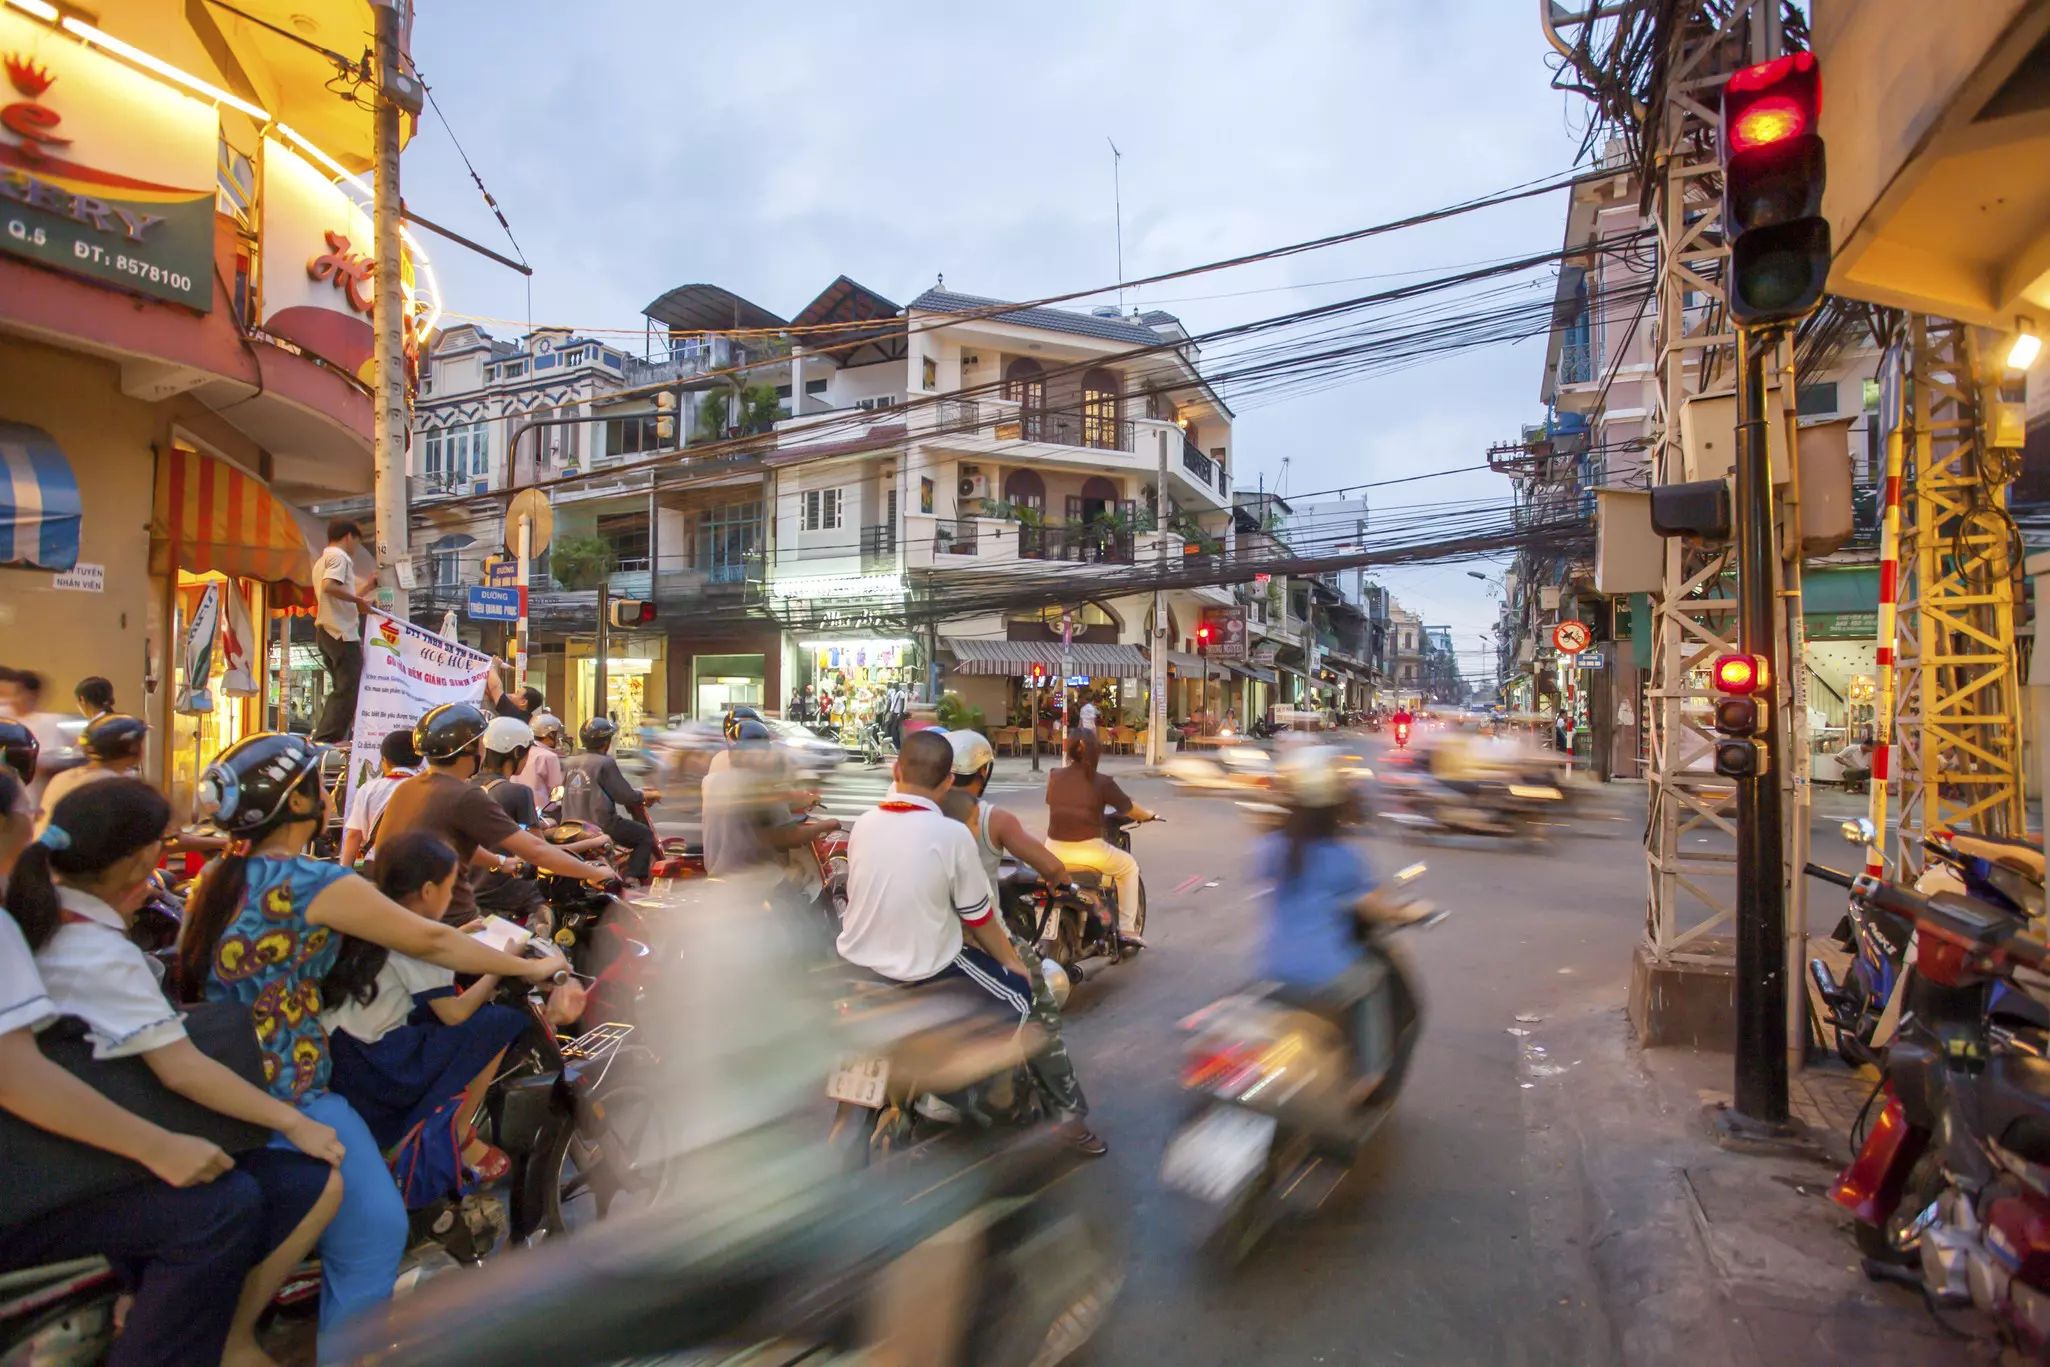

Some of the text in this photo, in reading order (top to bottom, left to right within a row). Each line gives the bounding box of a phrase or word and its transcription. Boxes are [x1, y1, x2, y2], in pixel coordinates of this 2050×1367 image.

[8, 220, 191, 291] Q.5 ĐT: 8578100
[1056, 621, 1083, 635] 37
